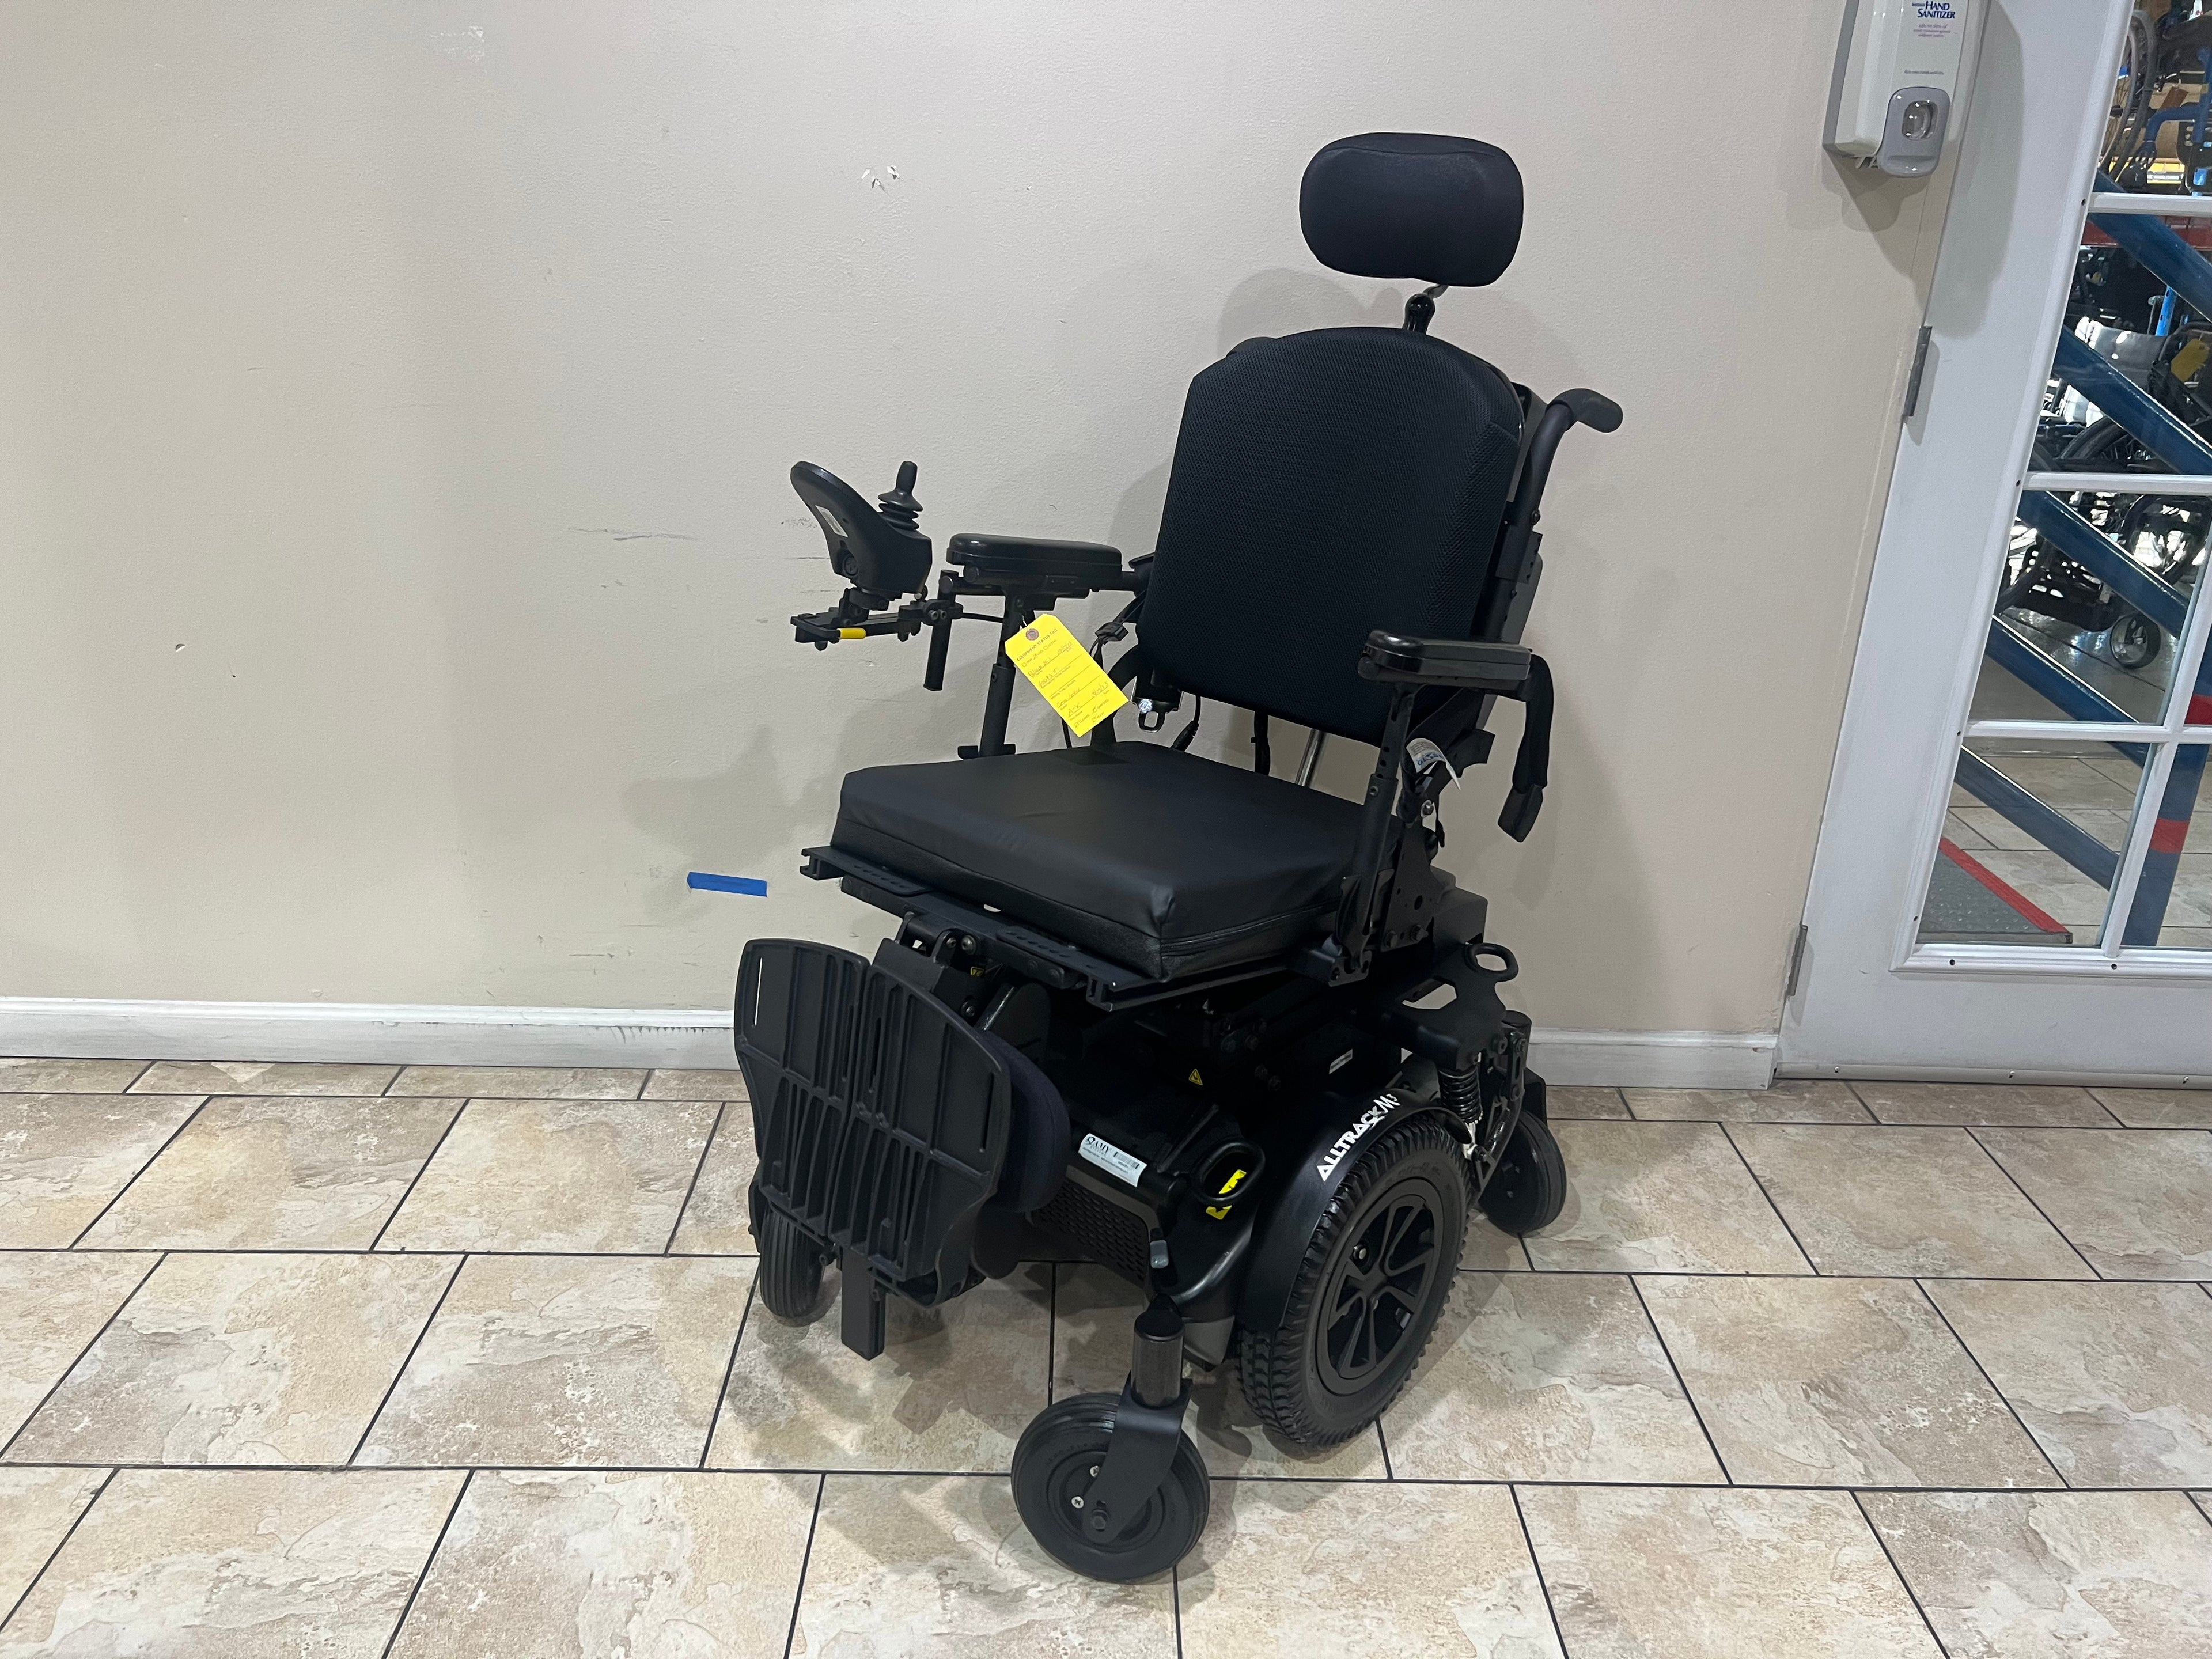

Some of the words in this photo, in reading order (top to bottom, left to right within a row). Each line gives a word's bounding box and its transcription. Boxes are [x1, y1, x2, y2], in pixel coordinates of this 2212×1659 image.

[1925, 1, 1950, 10] HAND
[1917, 8, 1956, 18] SANITIZER
[1017, 644, 1037, 661] EQUIPMENT
[1037, 634, 1050, 646] STATUS
